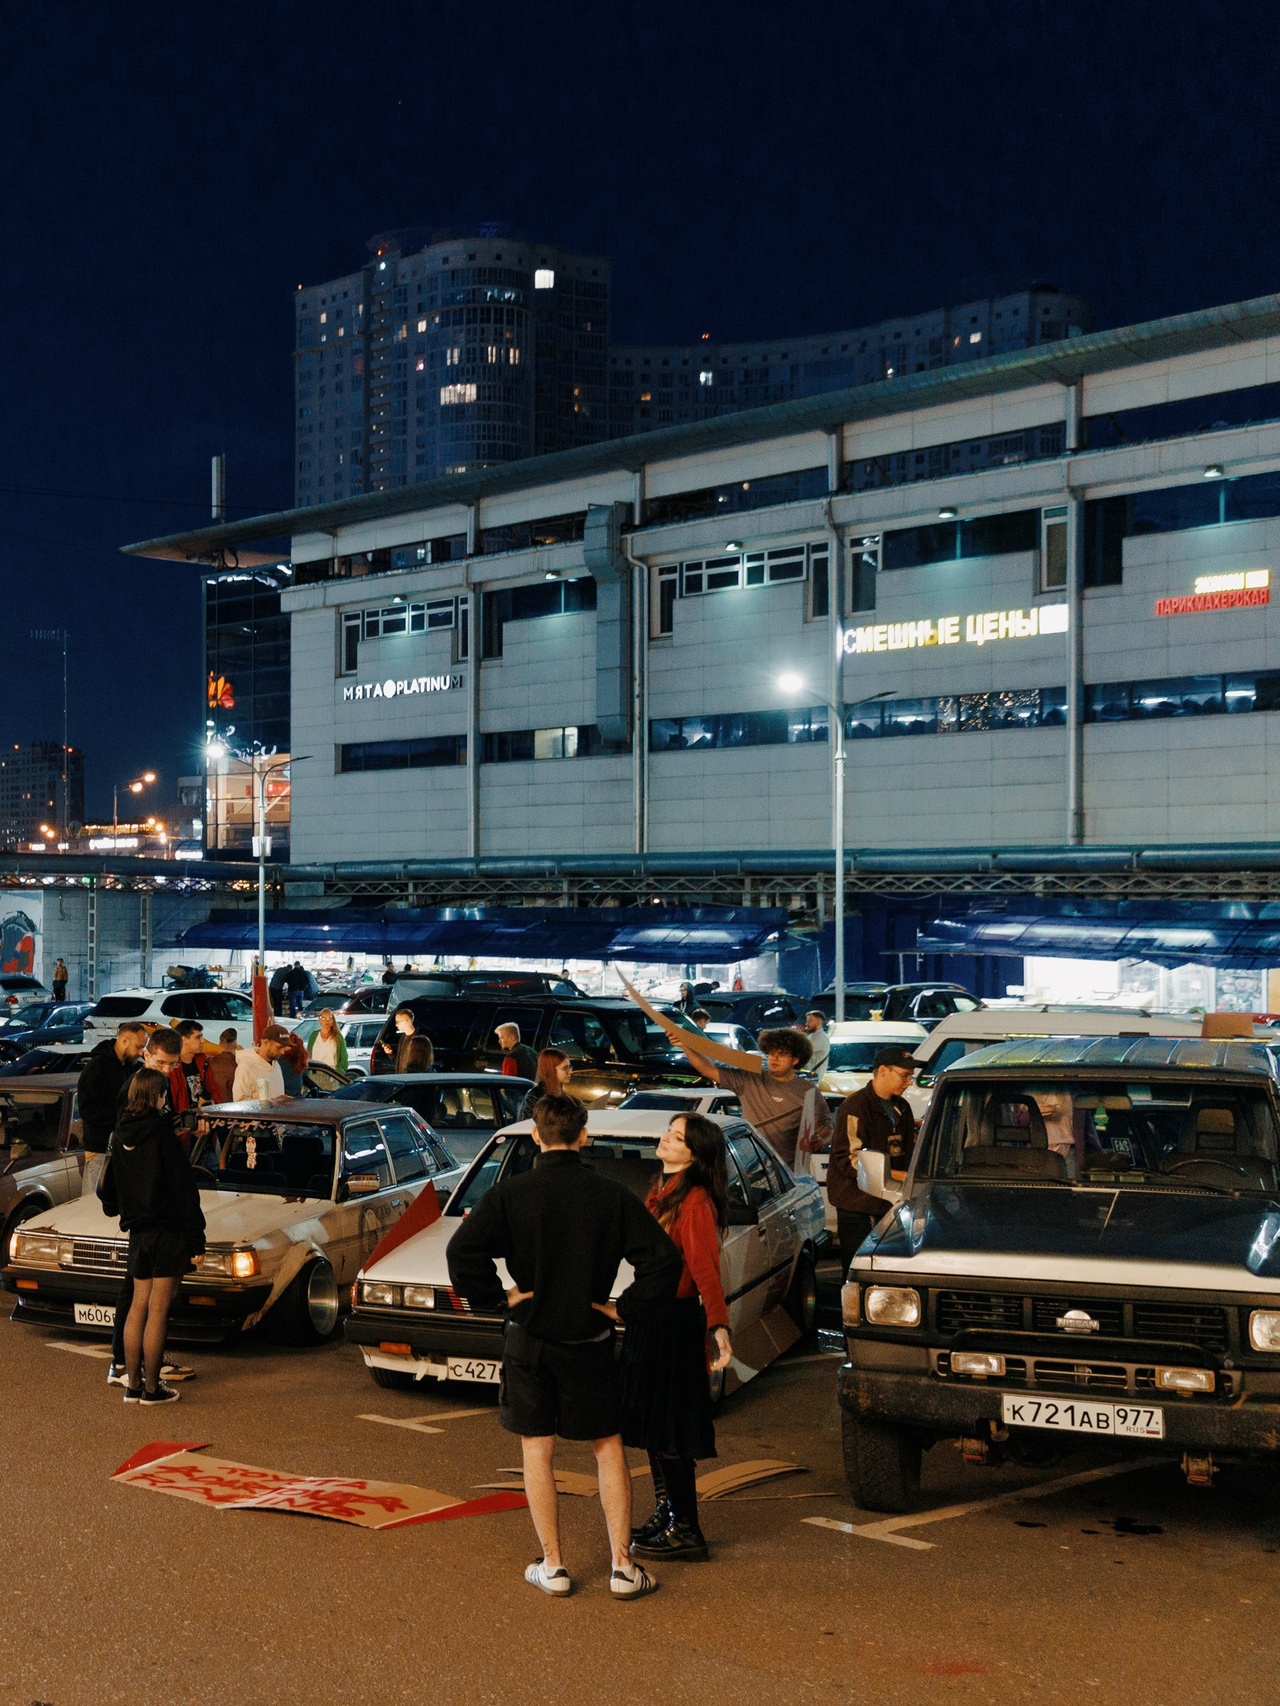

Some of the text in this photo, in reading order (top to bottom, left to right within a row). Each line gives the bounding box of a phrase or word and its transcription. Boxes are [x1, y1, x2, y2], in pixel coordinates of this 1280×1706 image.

[1155, 587, 1270, 616] ПАРИКМАХЕРСКАЯ
[843, 608, 1039, 654] СМЕШНЫЕ ЦЕНЫ
[343, 674, 463, 701] МЯТА PLATINUM
[1057, 1318, 1099, 1330] NISSAN
[453, 1361, 503, 1380] С427
[1011, 1400, 1155, 1430] К721АВ 977
[1125, 1425, 1145, 1435] RUS
[217, 1466, 368, 1490] TOYOTA
